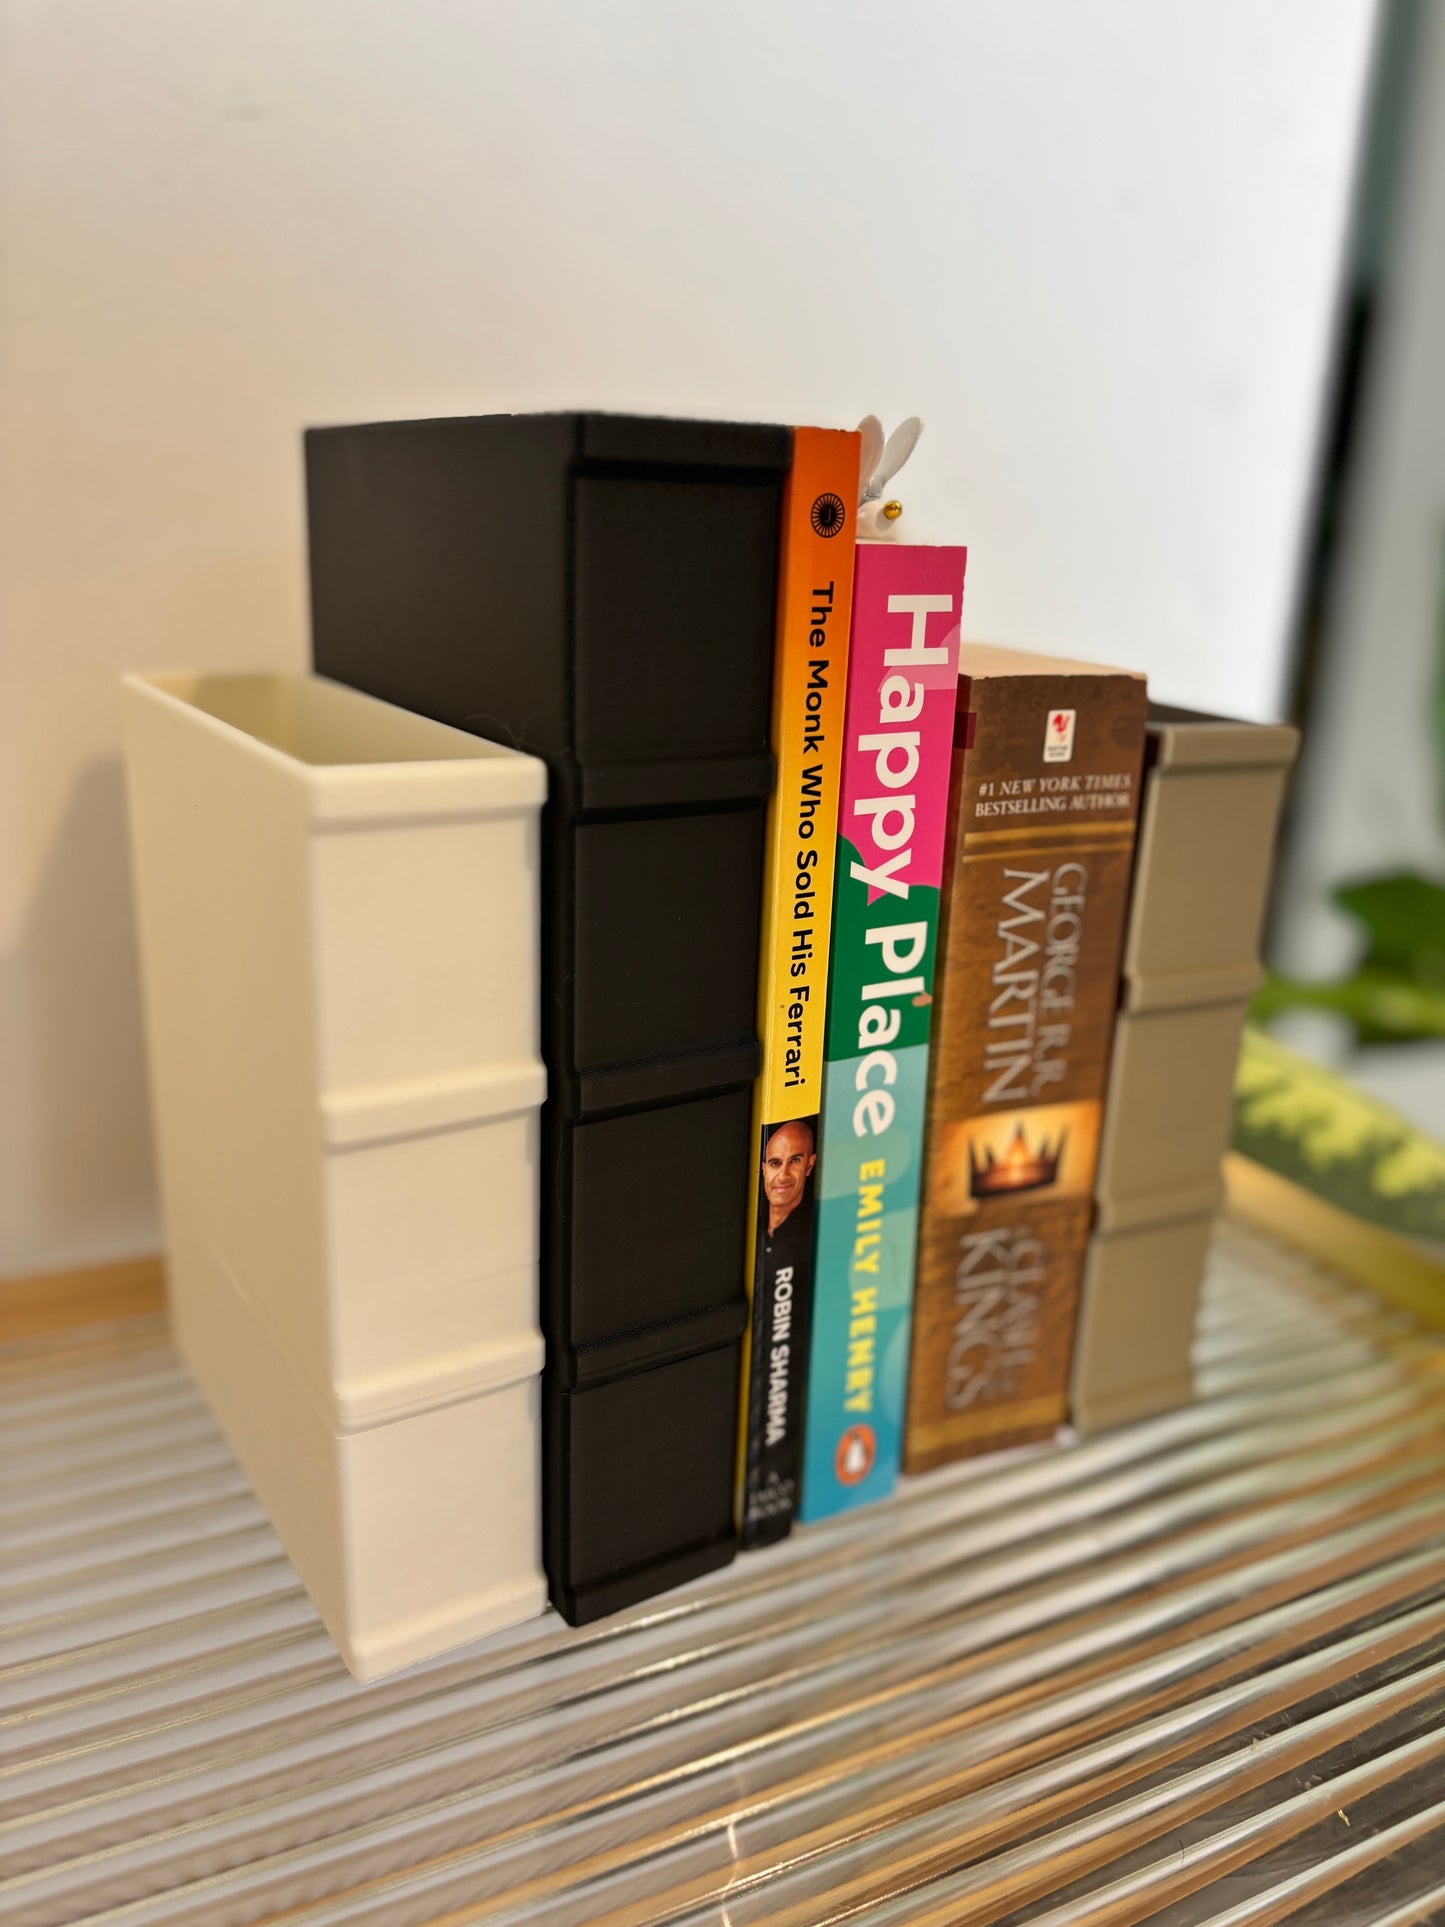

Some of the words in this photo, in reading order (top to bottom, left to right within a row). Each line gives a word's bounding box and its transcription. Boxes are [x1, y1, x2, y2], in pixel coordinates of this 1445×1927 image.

[809, 581, 834, 647] The
[803, 660, 829, 754] Monk
[850, 594, 953, 900] Happy
[798, 764, 823, 839] Who
[975, 796, 1067, 817] BESTSELLING
[1069, 791, 1131, 811] AUTHOR
[978, 782, 995, 797] #1
[999, 778, 1036, 796] NEW
[1039, 775, 1082, 793] YORK
[1084, 772, 1132, 790] TIMES
[794, 850, 818, 919] Sold
[790, 929, 813, 977] His
[981, 867, 1050, 1103] MARTIN
[1038, 862, 1088, 1018] GEORGE
[784, 985, 810, 1088] Ferrari
[852, 921, 928, 1138] Place
[853, 1158, 886, 1275] EMILY
[772, 1266, 794, 1342] ROBIN
[843, 1286, 878, 1413] HENRY
[945, 1226, 1011, 1411] KINGS
[765, 1344, 790, 1446] SHARMA
